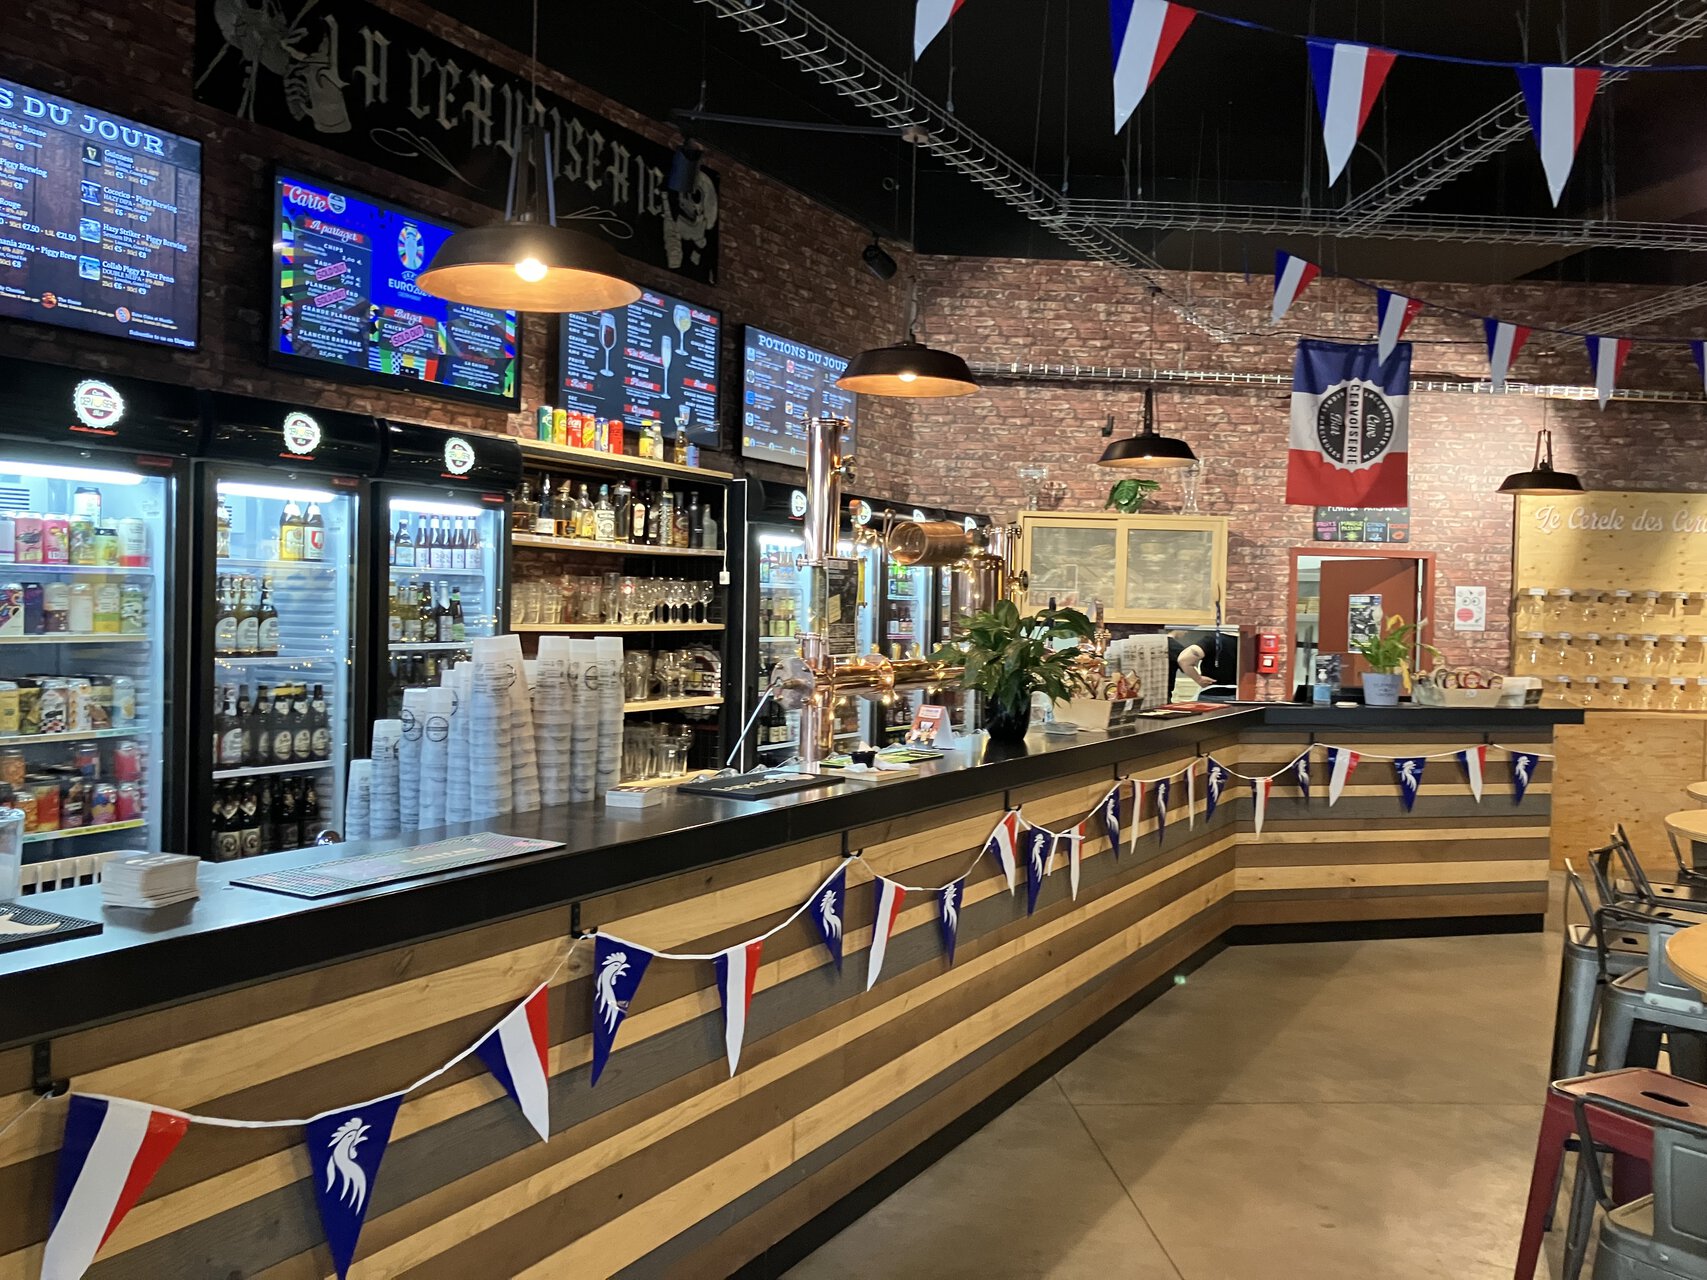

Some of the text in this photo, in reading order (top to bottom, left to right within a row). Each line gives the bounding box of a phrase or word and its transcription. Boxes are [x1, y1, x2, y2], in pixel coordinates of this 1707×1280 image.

[23, 95, 72, 125] DU
[80, 114, 165, 156] JOUR
[19, 162, 48, 178] Brewing
[153, 200, 178, 214] Brewing
[288, 186, 327, 212] Carte
[22, 223, 40, 233] €7.50
[56, 231, 77, 242] €21.50
[103, 223, 120, 235] Hazy
[120, 228, 141, 239] Striker
[163, 239, 187, 252] Brewing
[320, 225, 358, 243] partager
[18, 242, 35, 253] 2024
[41, 246, 59, 258] Piggy
[60, 250, 78, 261] Brew
[323, 243, 344, 253] CHIPS
[102, 260, 123, 271] Collab
[401, 270, 418, 279] UEF
[388, 278, 432, 298] EURO20
[302, 305, 329, 316] GRANDE
[330, 311, 361, 323] PLANCHE
[394, 308, 423, 326] Burger
[383, 323, 406, 332] CHICK
[299, 329, 330, 341] PLANCHE
[331, 337, 362, 348] BARBARE
[758, 334, 806, 360] POTIONS
[807, 350, 822, 364] DU
[1330, 412, 1343, 436] Bar
[1347, 384, 1360, 465] CERVOISERIE
[1366, 414, 1380, 438] Cave
[1535, 505, 1561, 534] Le
[1568, 506, 1625, 531] Cercle
[1631, 508, 1664, 531] des
